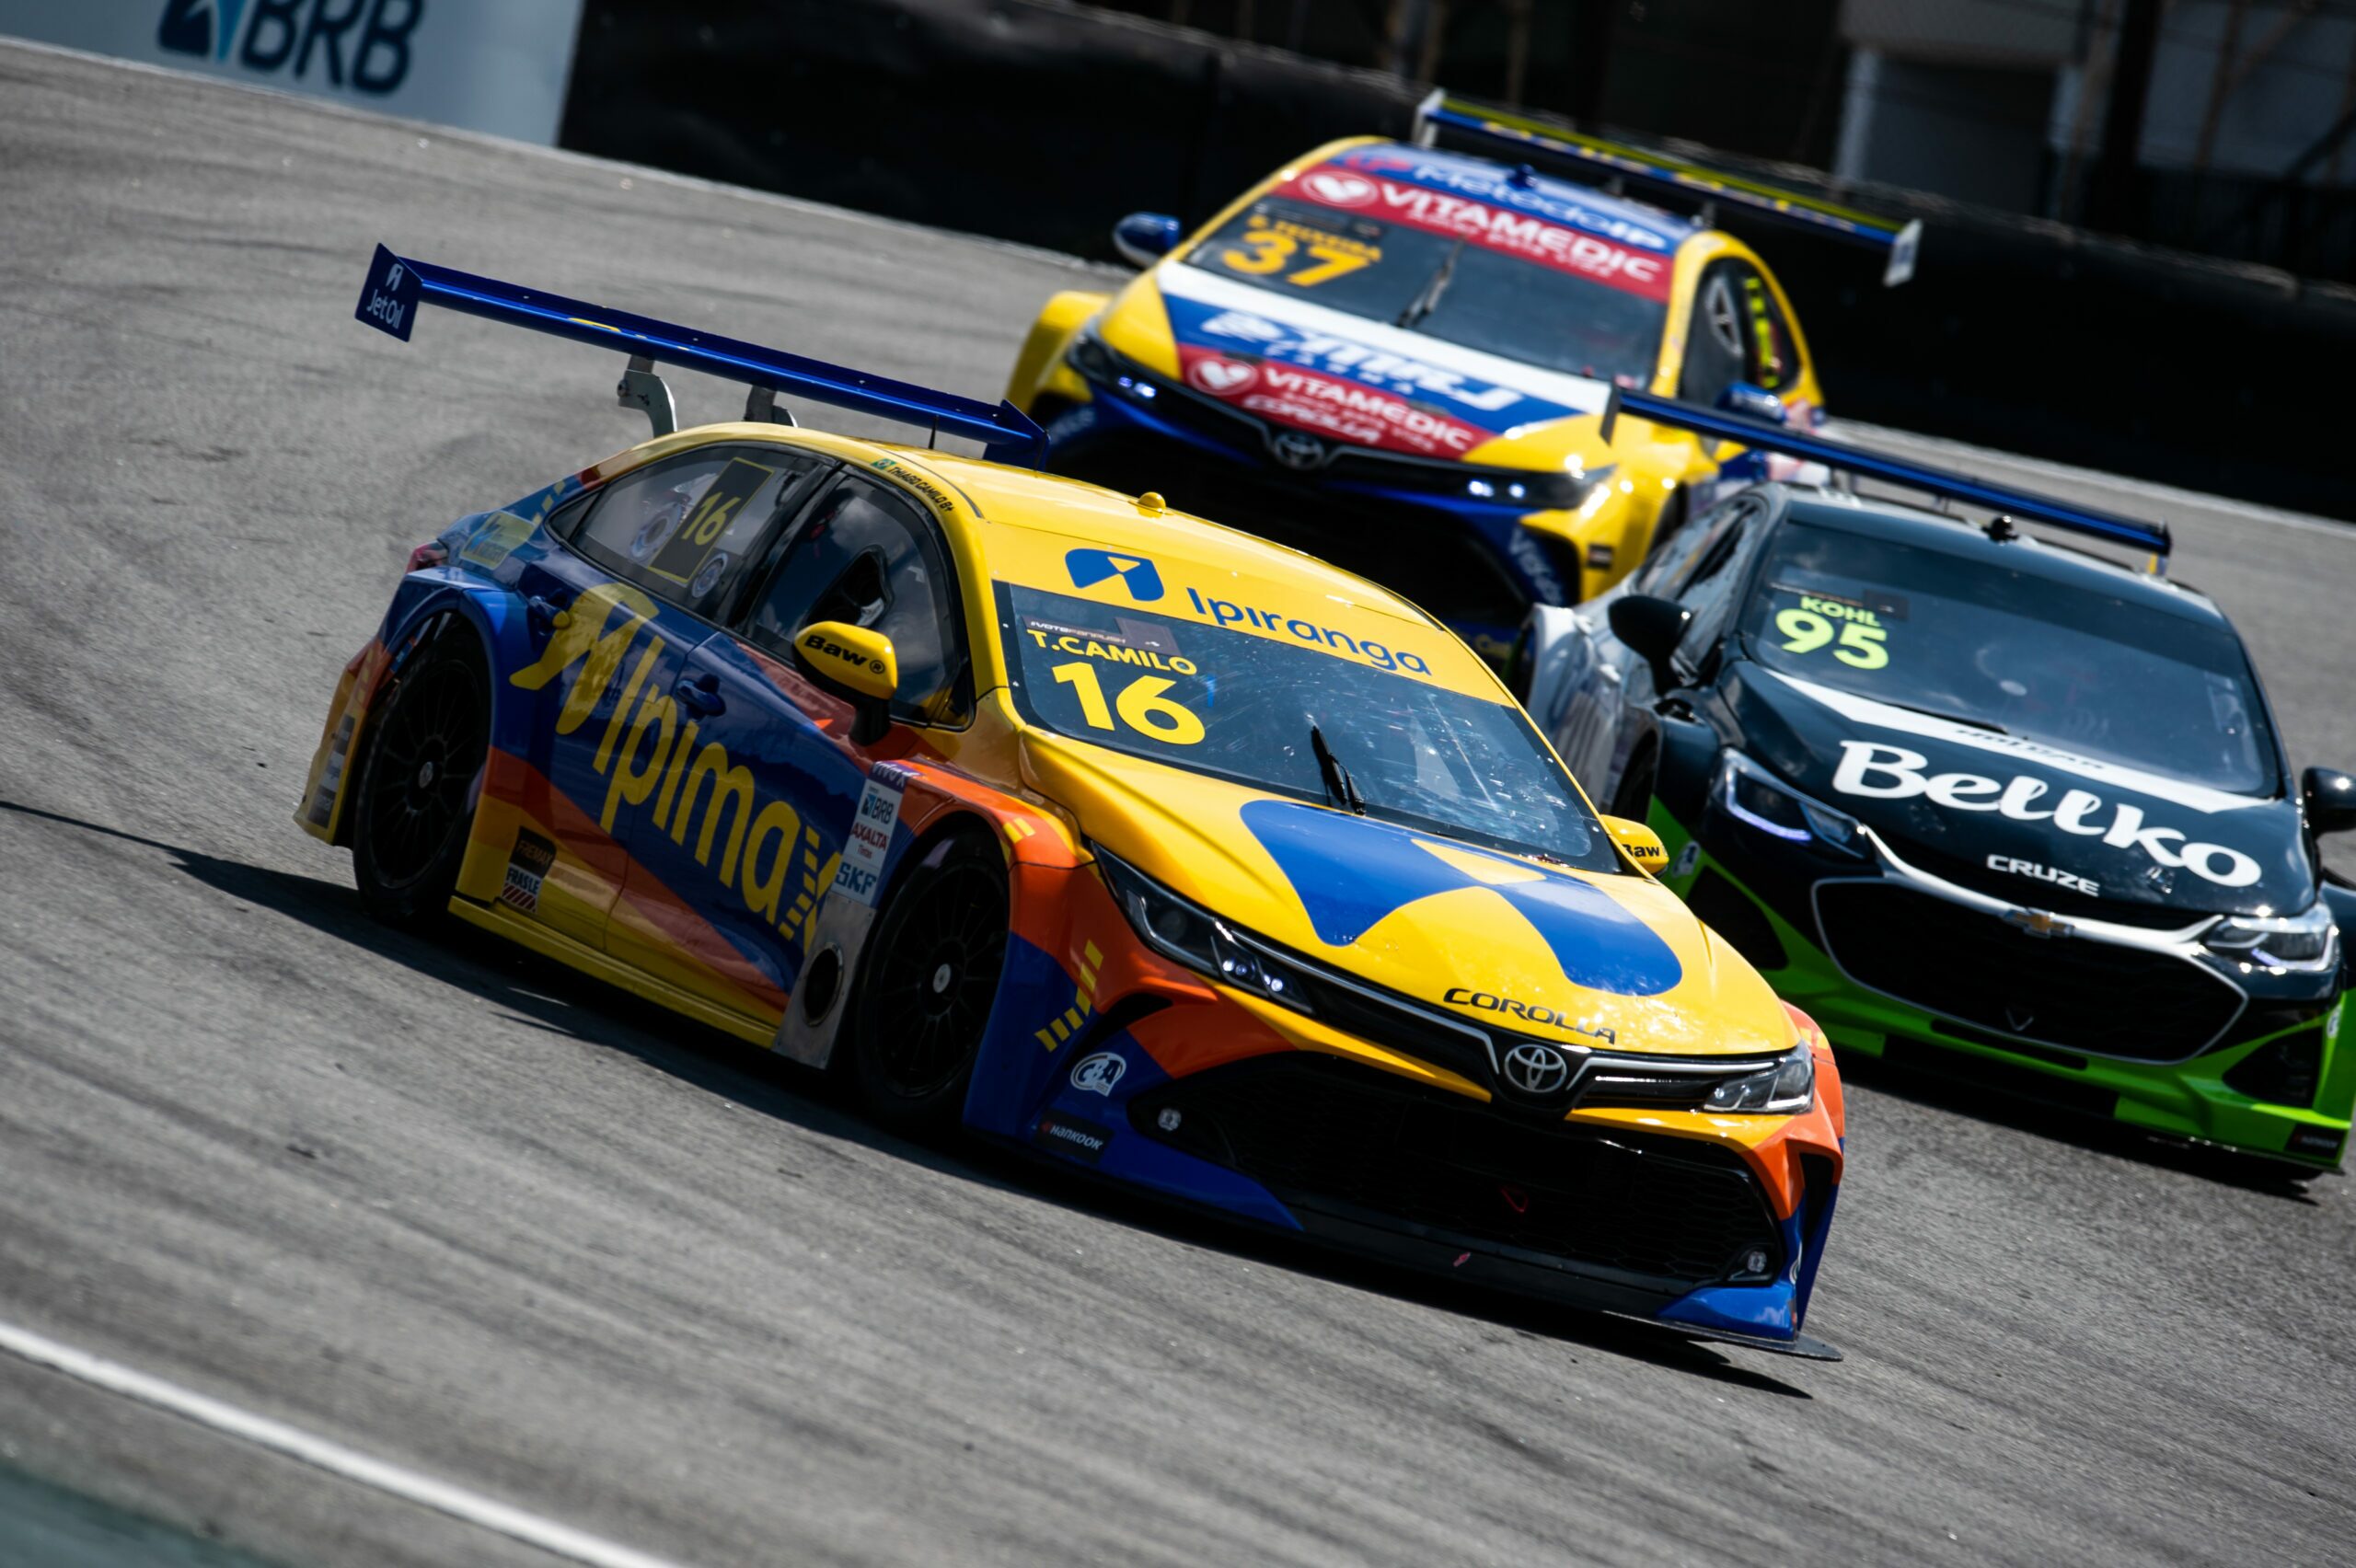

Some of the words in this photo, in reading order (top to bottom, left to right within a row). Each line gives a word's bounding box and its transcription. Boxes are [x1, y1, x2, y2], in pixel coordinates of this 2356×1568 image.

[239, 0, 424, 96] BRB
[1221, 230, 1370, 287] 37
[1381, 183, 1661, 282] VITAMEDIC
[1265, 367, 1473, 451] VITAMEDIC
[681, 491, 742, 546] 16
[1185, 586, 1433, 677] Ipiranga
[1775, 608, 1889, 670] 95
[1800, 595, 1882, 628] KOHL
[803, 634, 868, 666] Baw
[1026, 628, 1197, 675] T.CAMILO
[1051, 662, 1206, 745] 16
[850, 821, 890, 852] AXALTA
[871, 796, 895, 825] BRB
[1831, 739, 2263, 888] Bellko
[835, 861, 877, 896] SKF
[1986, 852, 2101, 898] CRUZE
[1443, 987, 1617, 1046] COROLLA
